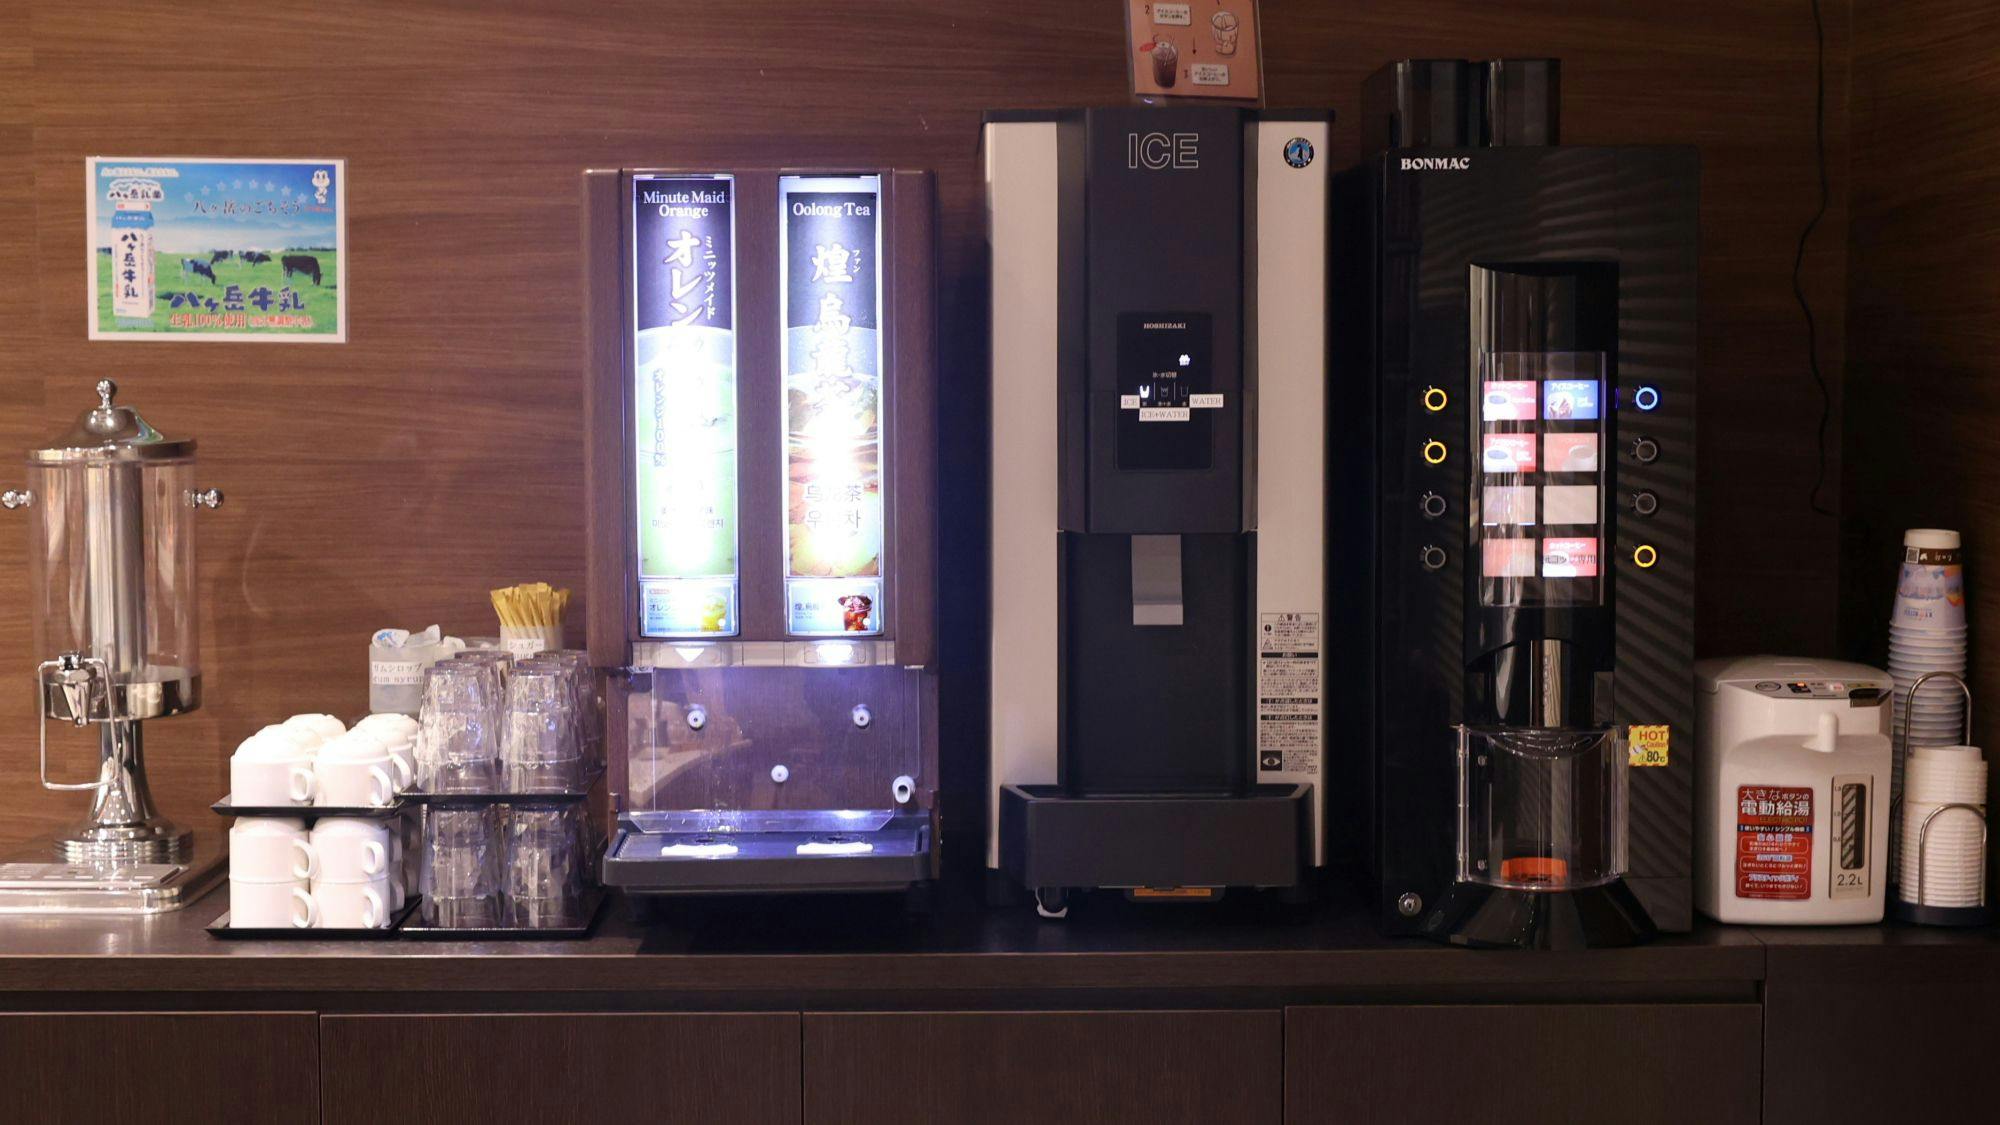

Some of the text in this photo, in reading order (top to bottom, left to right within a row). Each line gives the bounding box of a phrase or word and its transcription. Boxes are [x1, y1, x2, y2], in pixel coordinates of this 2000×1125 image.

[1128, 132, 1199, 170] ICE
[1400, 157, 1471, 170] BONMAC
[643, 191, 725, 204] Minute Maid
[658, 204, 709, 218] Orange
[792, 202, 871, 218] Oolong Tea
[703, 235, 718, 320] ミニッツメイド
[1143, 322, 1187, 330] HOSHIZAKI
[1191, 396, 1222, 405] WATER
[1639, 730, 1666, 741] HOT
[1741, 788, 1810, 801] 大きなボタンの
[1740, 799, 1810, 817] 電動給湯
